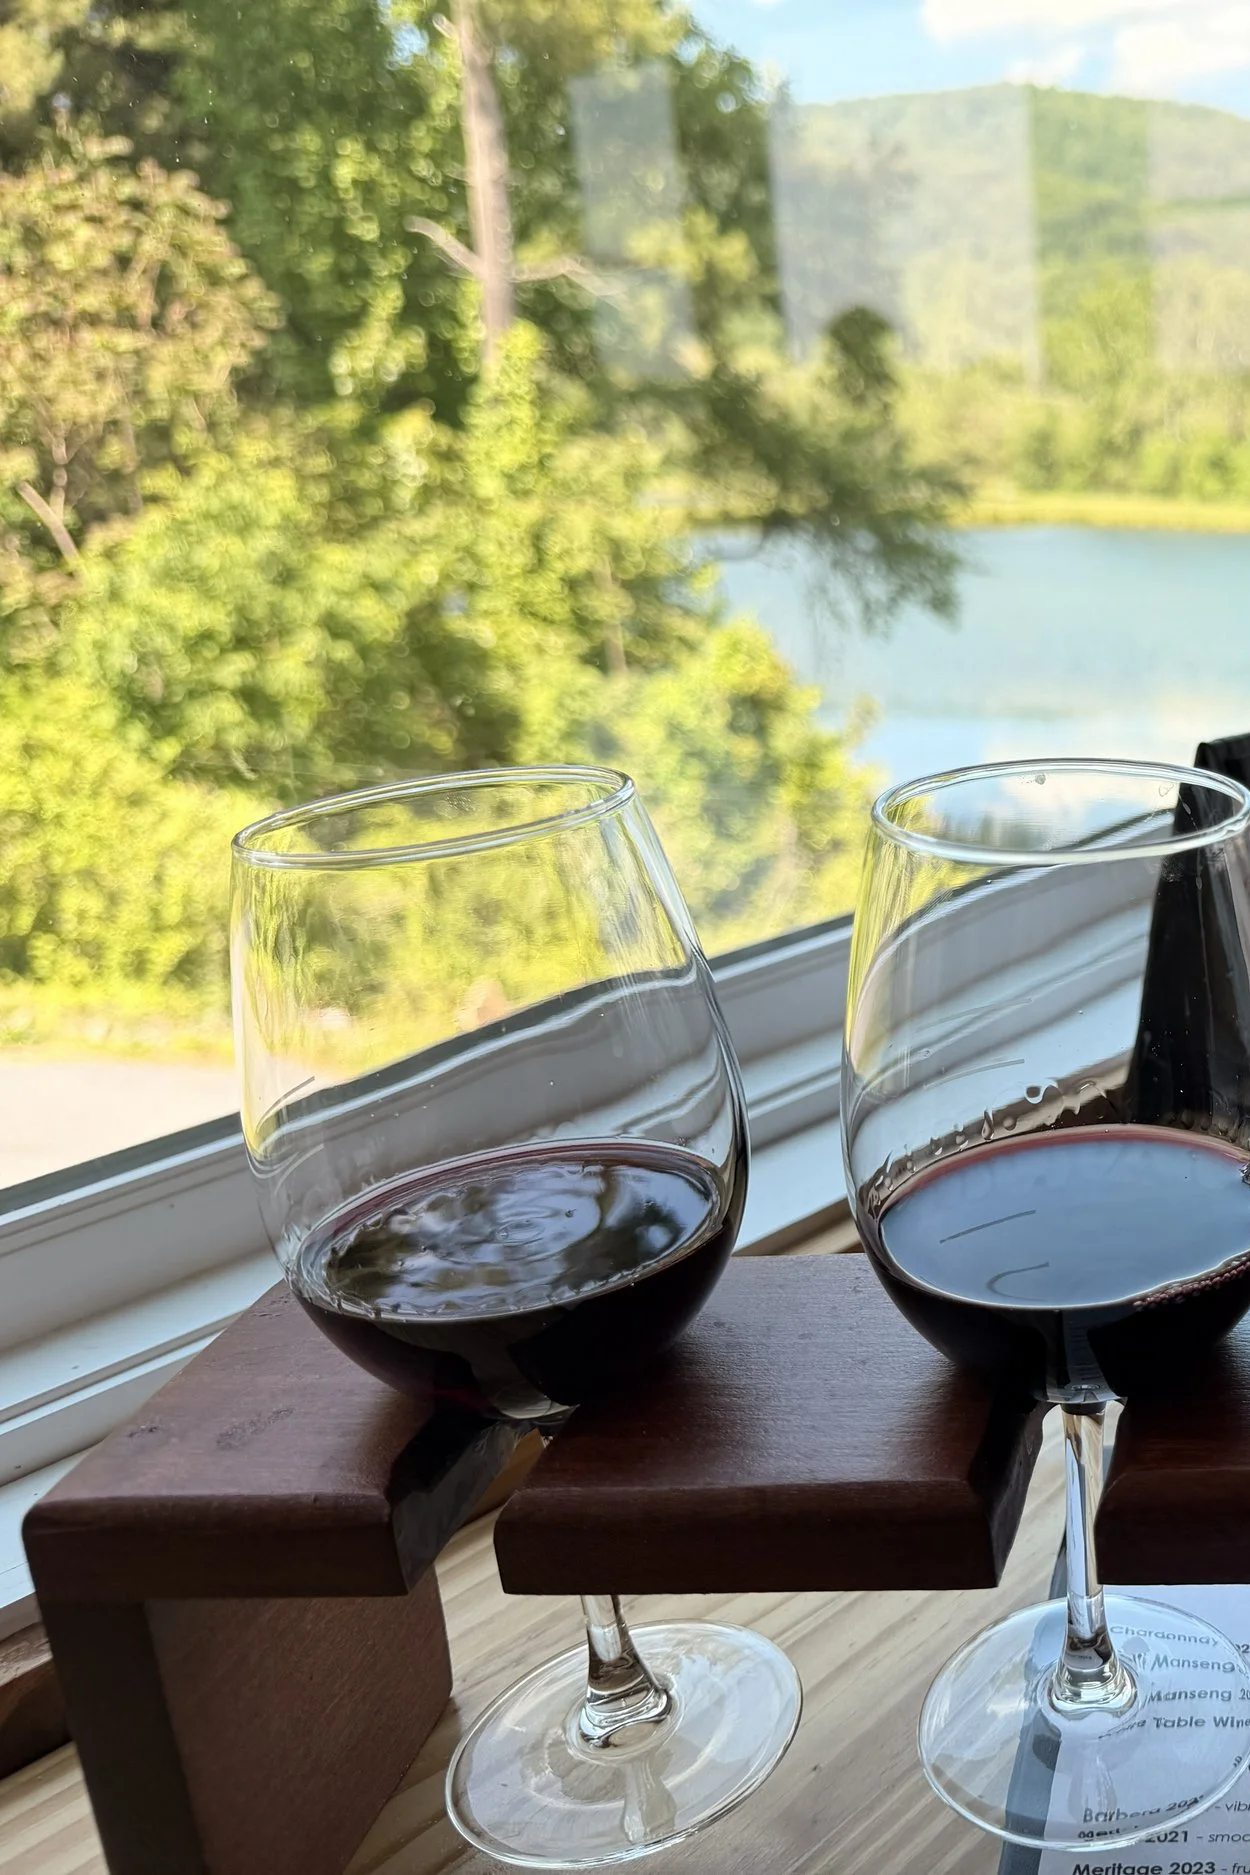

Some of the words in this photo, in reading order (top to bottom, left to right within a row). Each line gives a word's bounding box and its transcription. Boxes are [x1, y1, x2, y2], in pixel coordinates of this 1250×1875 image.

[1110, 1625, 1218, 1648] Chardonnay
[1151, 1653, 1235, 1673] Manseng
[1148, 1690, 1232, 1702] Manseng
[1153, 1716, 1206, 1729] Table
[1072, 1862, 1162, 1875] Meritage
[1168, 1862, 1216, 1875] 2023
